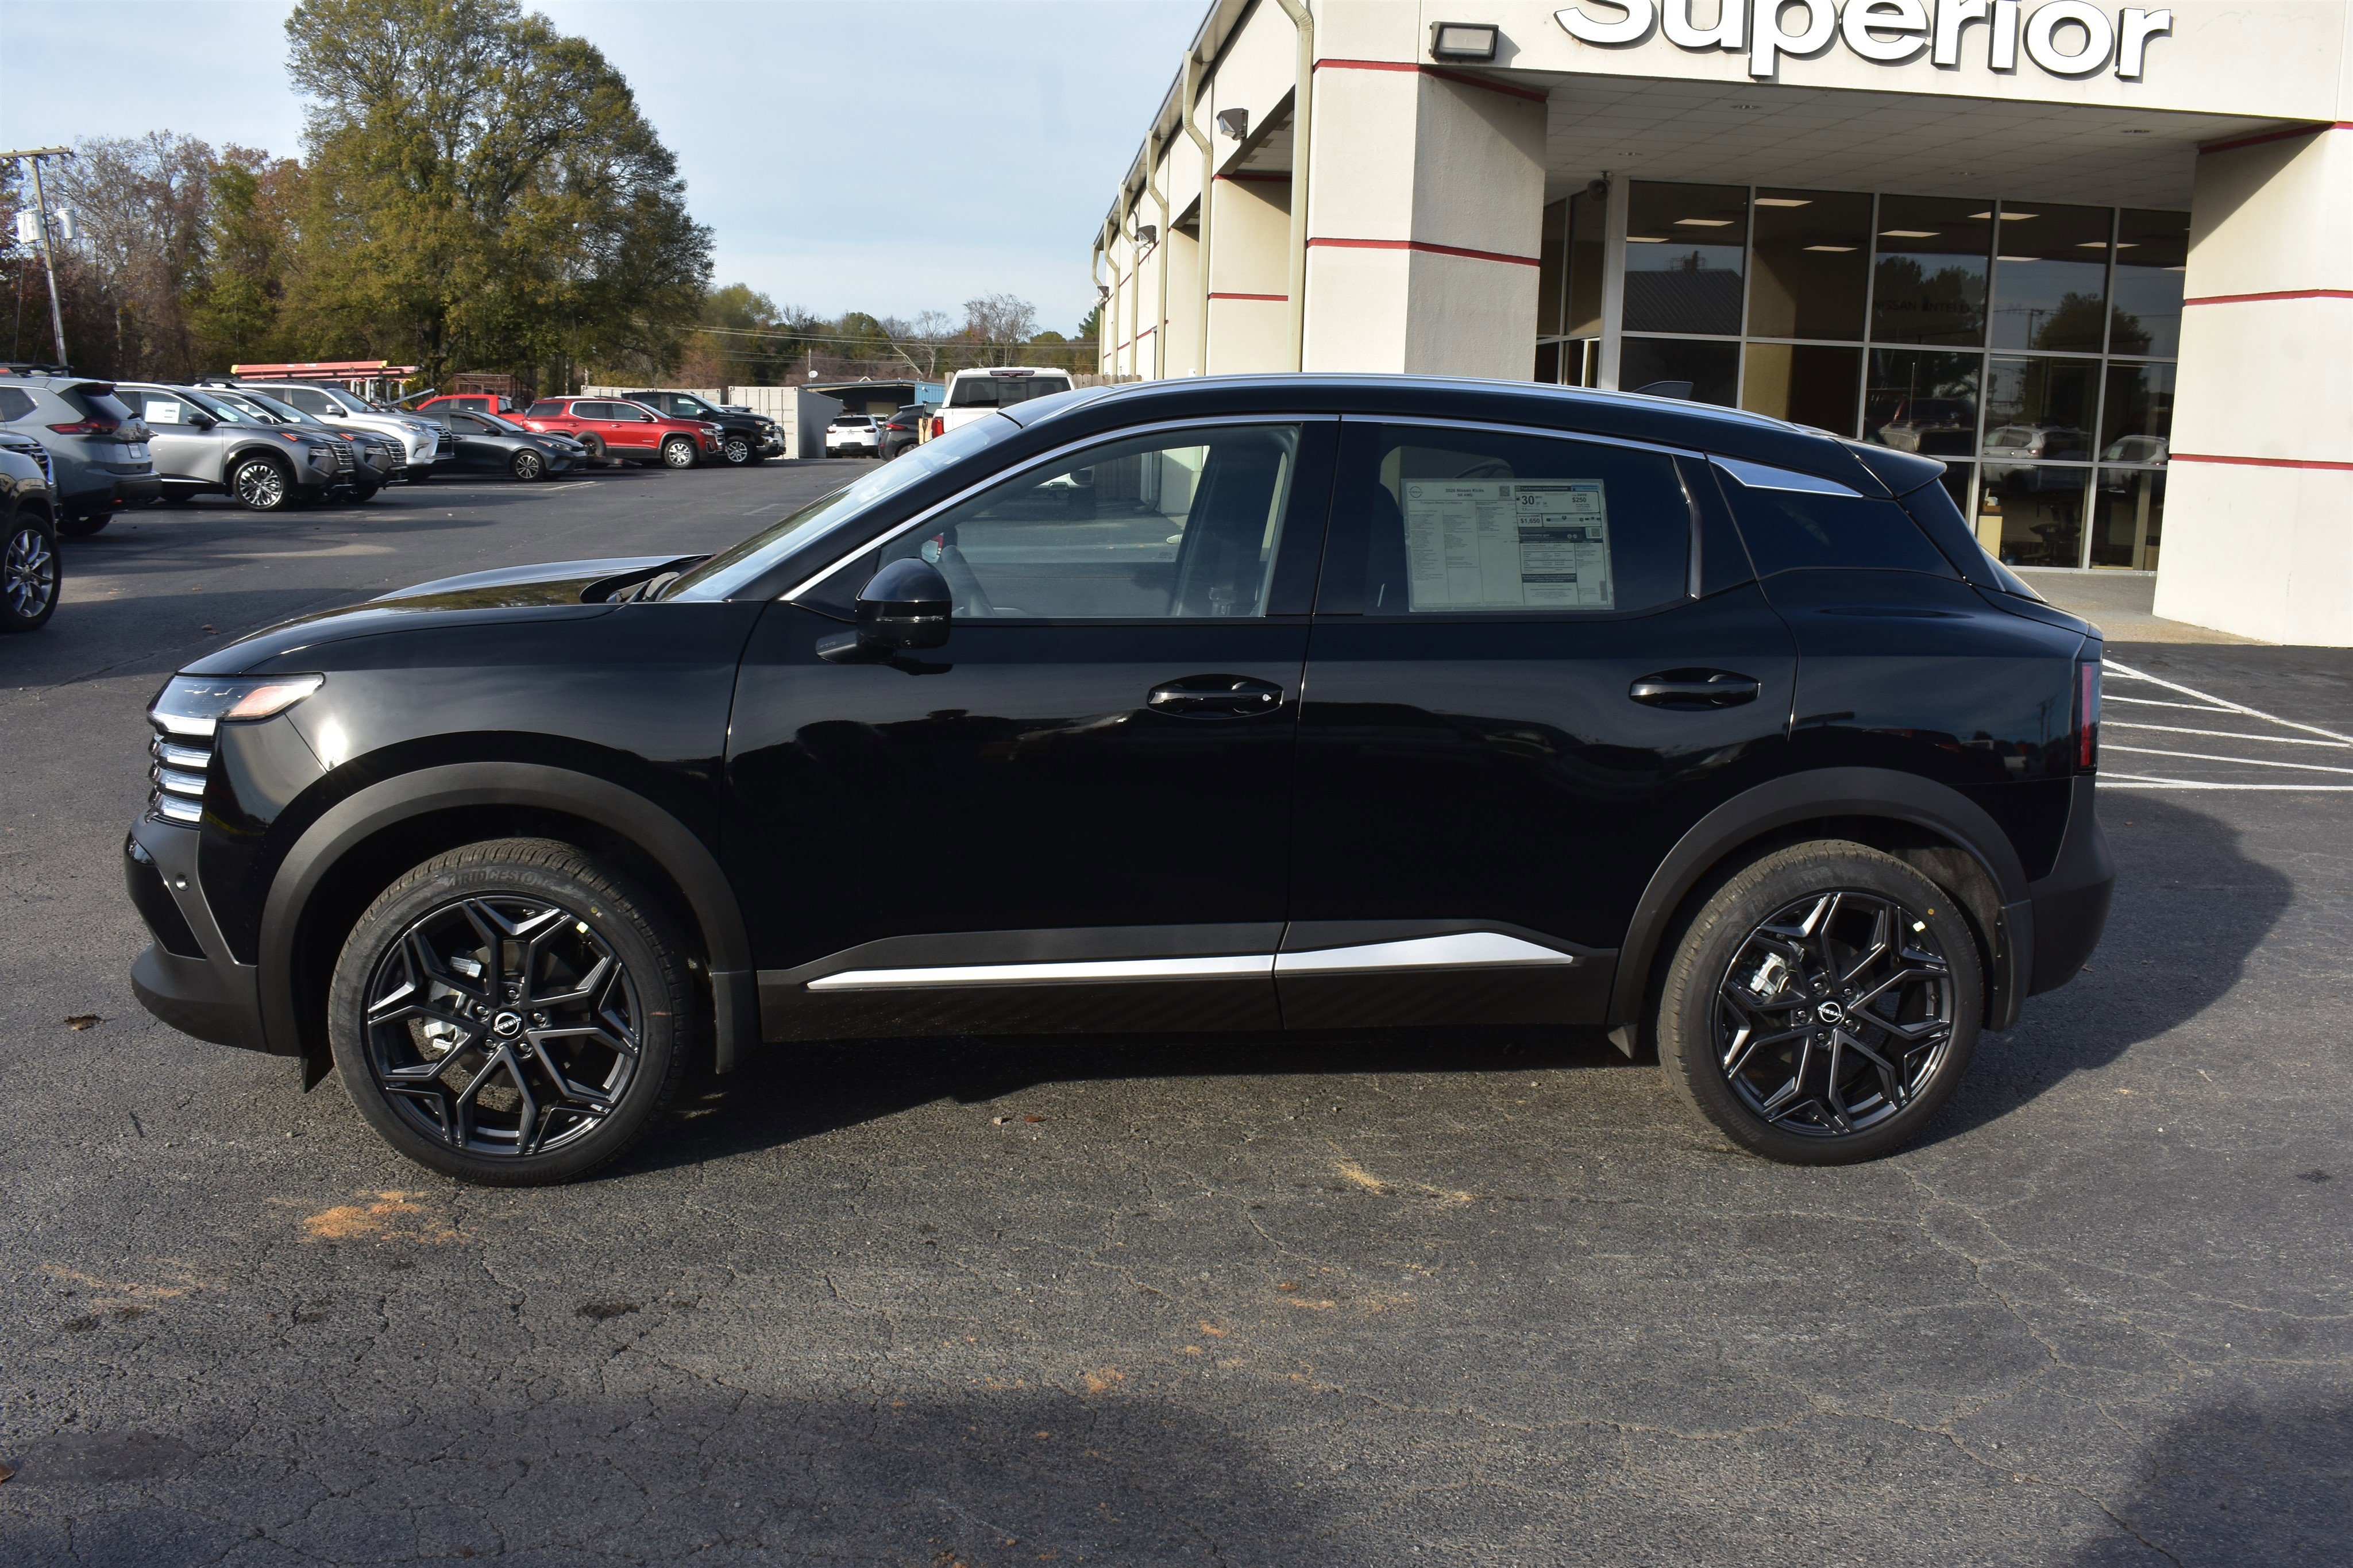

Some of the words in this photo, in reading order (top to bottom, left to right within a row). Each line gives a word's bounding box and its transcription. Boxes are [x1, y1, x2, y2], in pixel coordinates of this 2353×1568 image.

[1873, 299, 1916, 311] NISSAN
[1922, 296, 1985, 313] INTELLIGE
[1522, 495, 1534, 505] 30
[445, 870, 557, 890] BRIDGESTON
[1818, 1006, 1843, 1018] NISSAN
[493, 1017, 522, 1032] NISSAN
